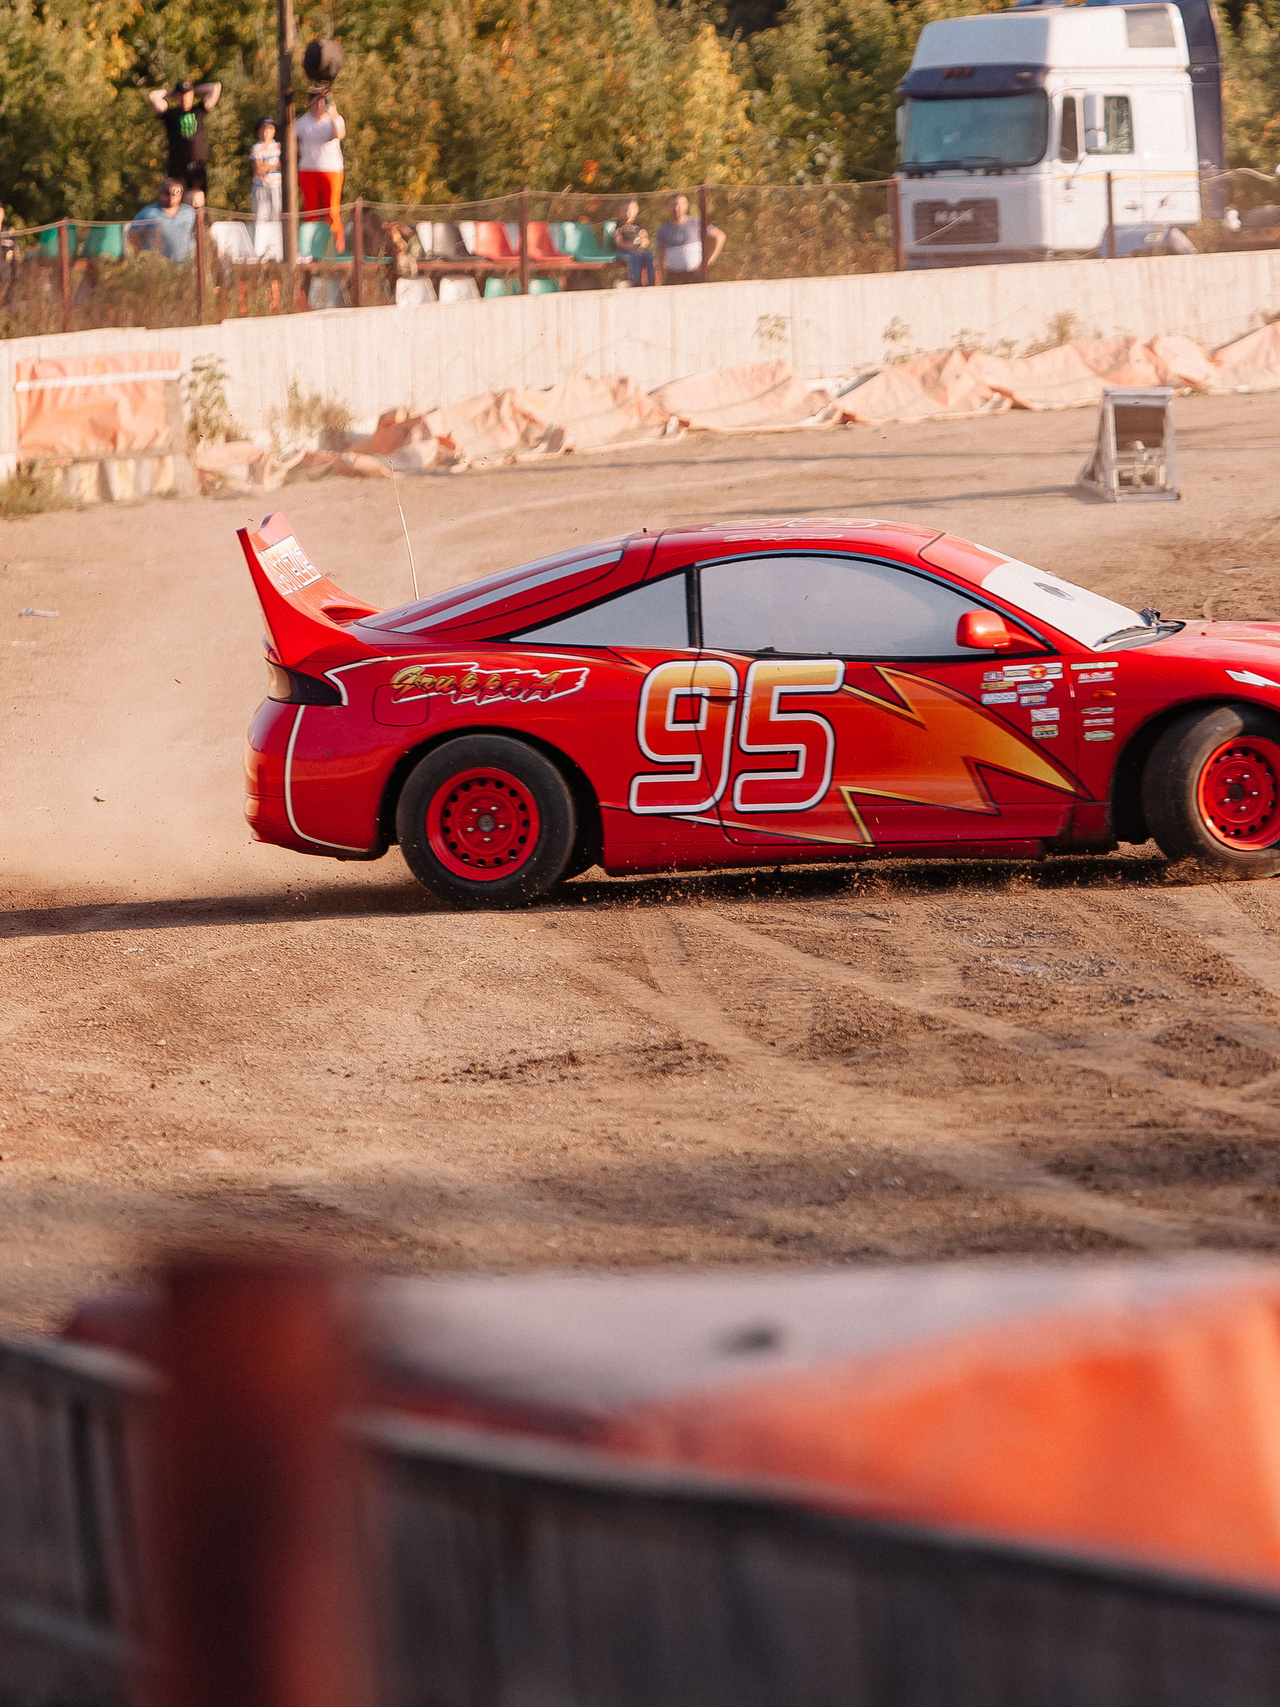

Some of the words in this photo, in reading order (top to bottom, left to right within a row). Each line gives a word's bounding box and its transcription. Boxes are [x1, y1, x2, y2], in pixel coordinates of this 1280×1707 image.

[390, 665, 522, 702] Gruppa
[521, 670, 563, 702] A
[629, 658, 846, 816] 95
